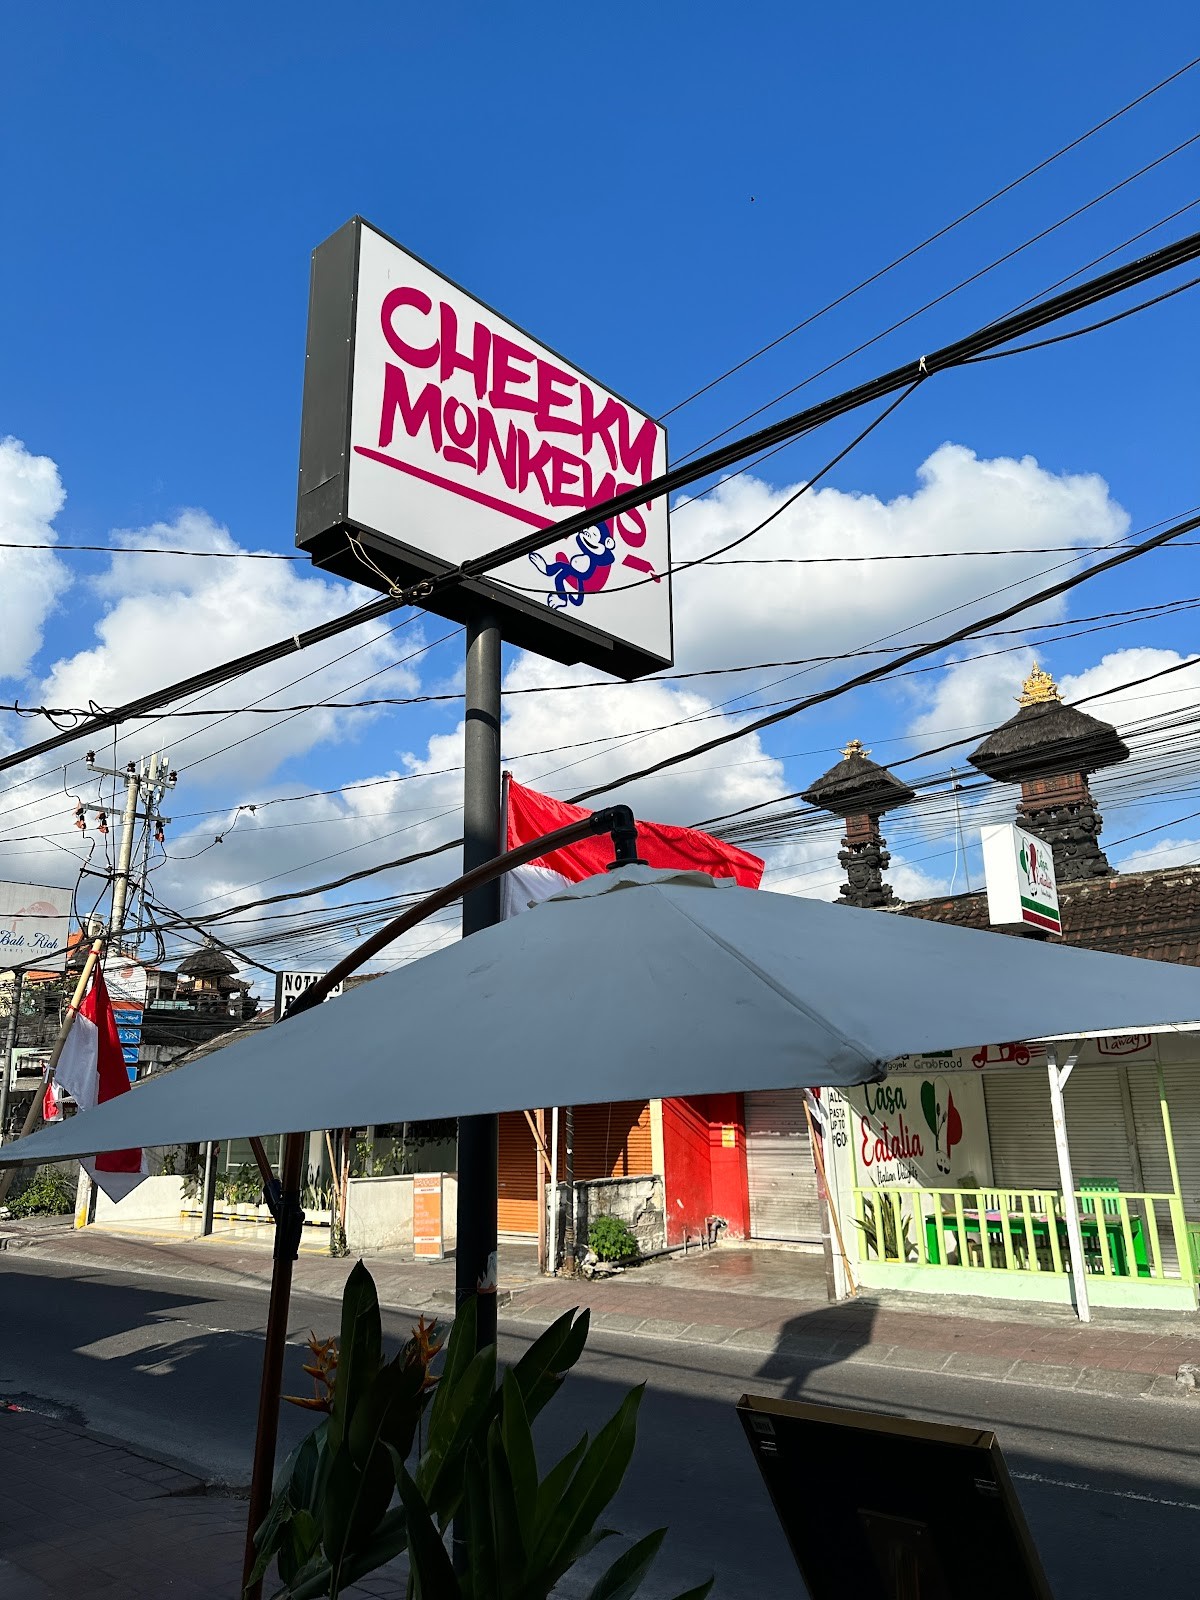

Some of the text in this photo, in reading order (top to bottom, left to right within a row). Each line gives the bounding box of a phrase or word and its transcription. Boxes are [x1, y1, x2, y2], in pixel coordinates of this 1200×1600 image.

[380, 286, 658, 511] CHEEKY
[377, 361, 650, 560] MONKEYS
[0, 929, 58, 949] Bali Rich
[887, 1061, 907, 1071] gojek
[913, 1056, 963, 1069] GrabFood
[864, 1082, 907, 1115] Casa
[861, 1113, 924, 1167] Eatalia
[876, 1162, 918, 1185] Italian Delights
